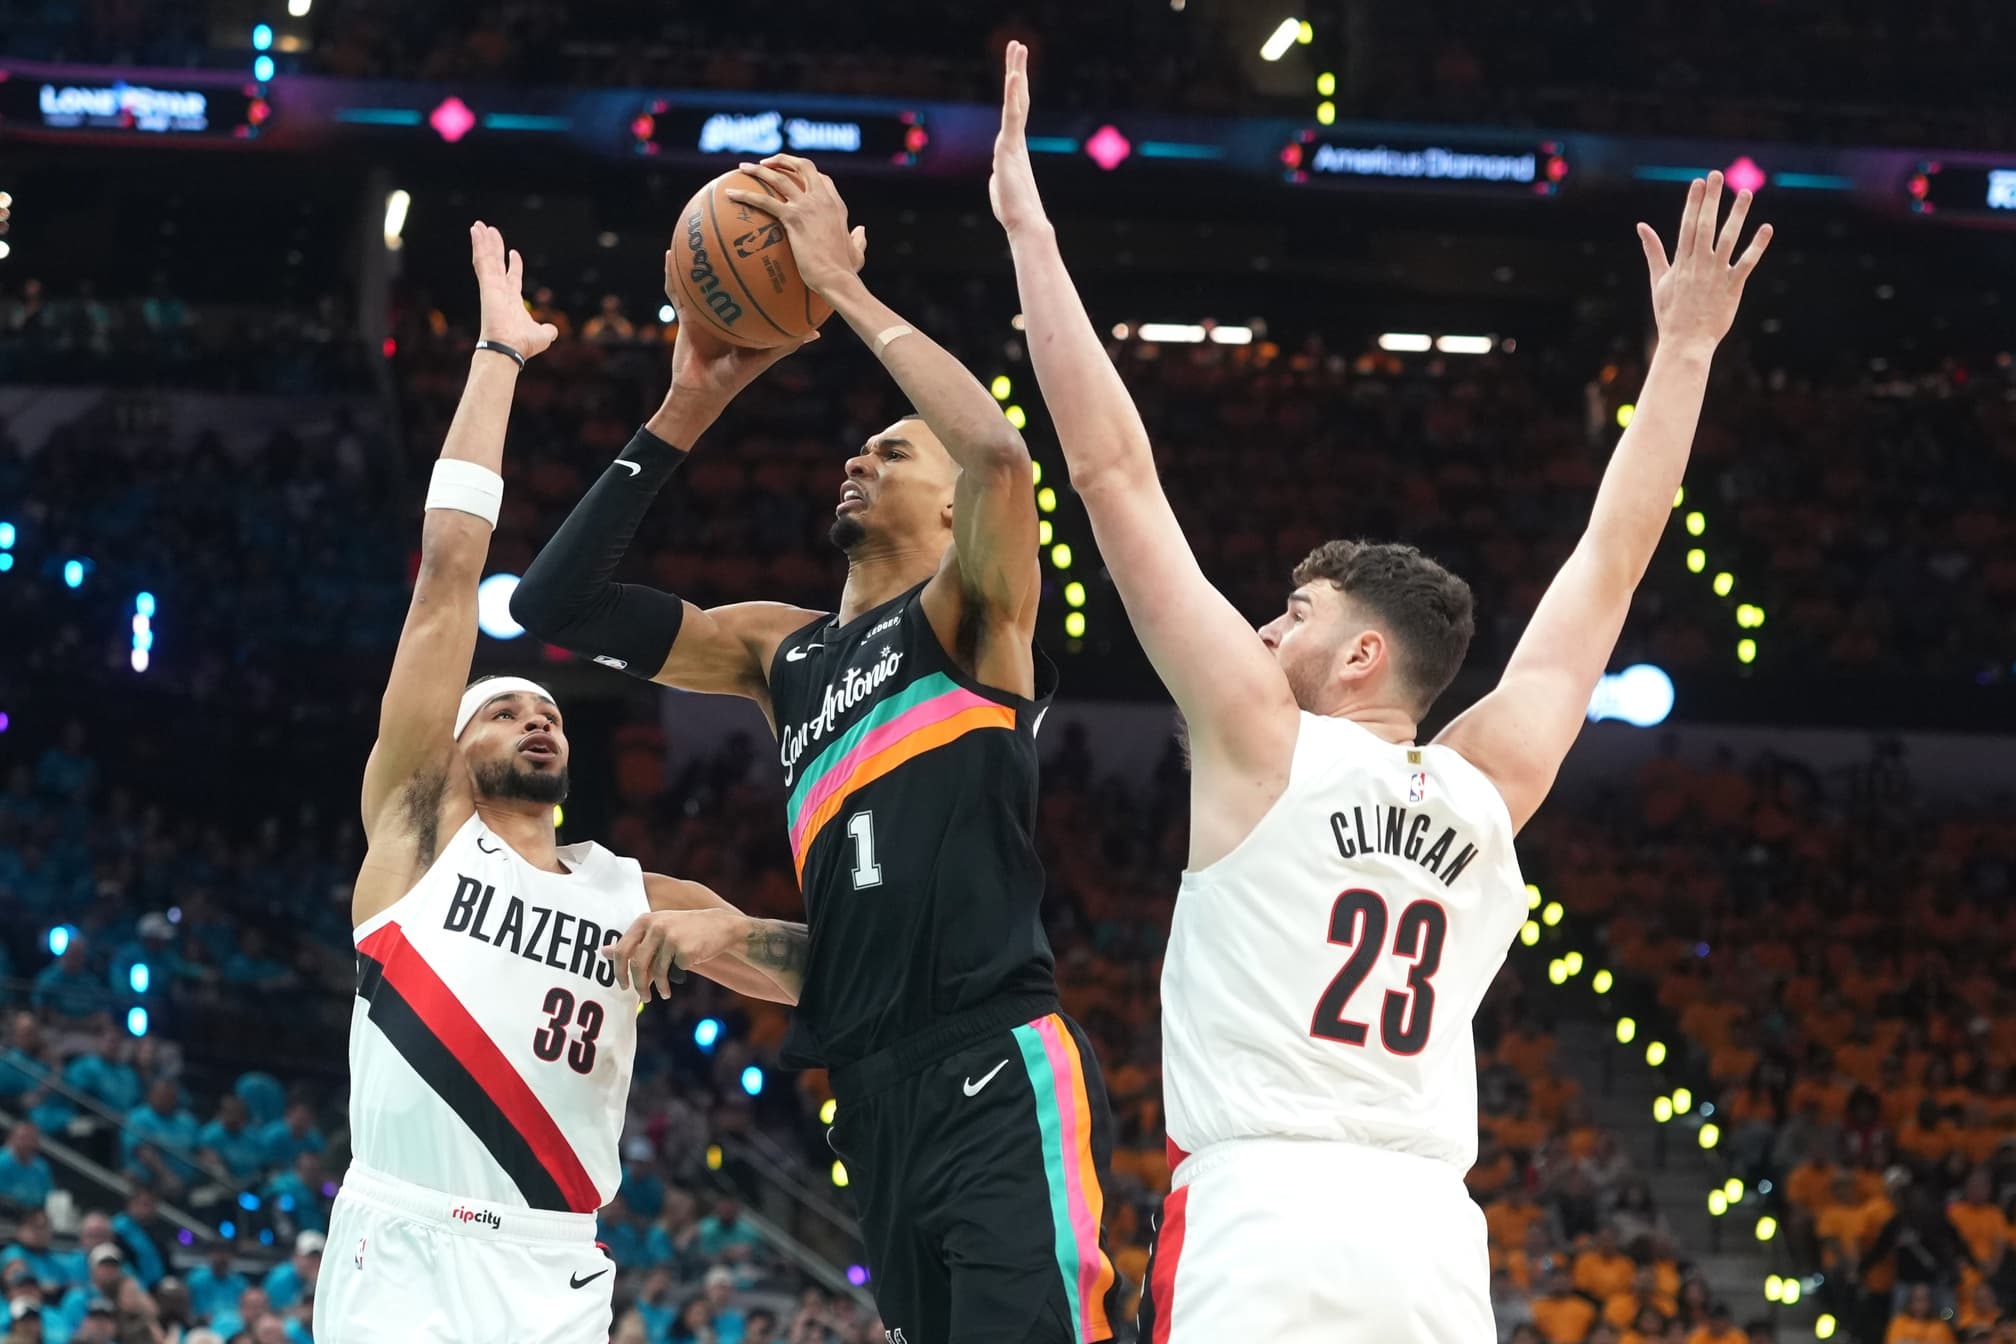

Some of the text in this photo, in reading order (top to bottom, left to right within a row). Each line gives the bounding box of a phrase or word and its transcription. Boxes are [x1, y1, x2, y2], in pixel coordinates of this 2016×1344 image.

[687, 208, 742, 327] Wilson
[780, 650, 904, 787] San Antonio
[847, 809, 883, 891] 1
[1330, 804, 1479, 887] CLINGAN
[443, 872, 623, 988] BLAZERS
[1309, 888, 1447, 1057] 23
[533, 987, 605, 1075] 33
[452, 1206, 501, 1229] ripcity
